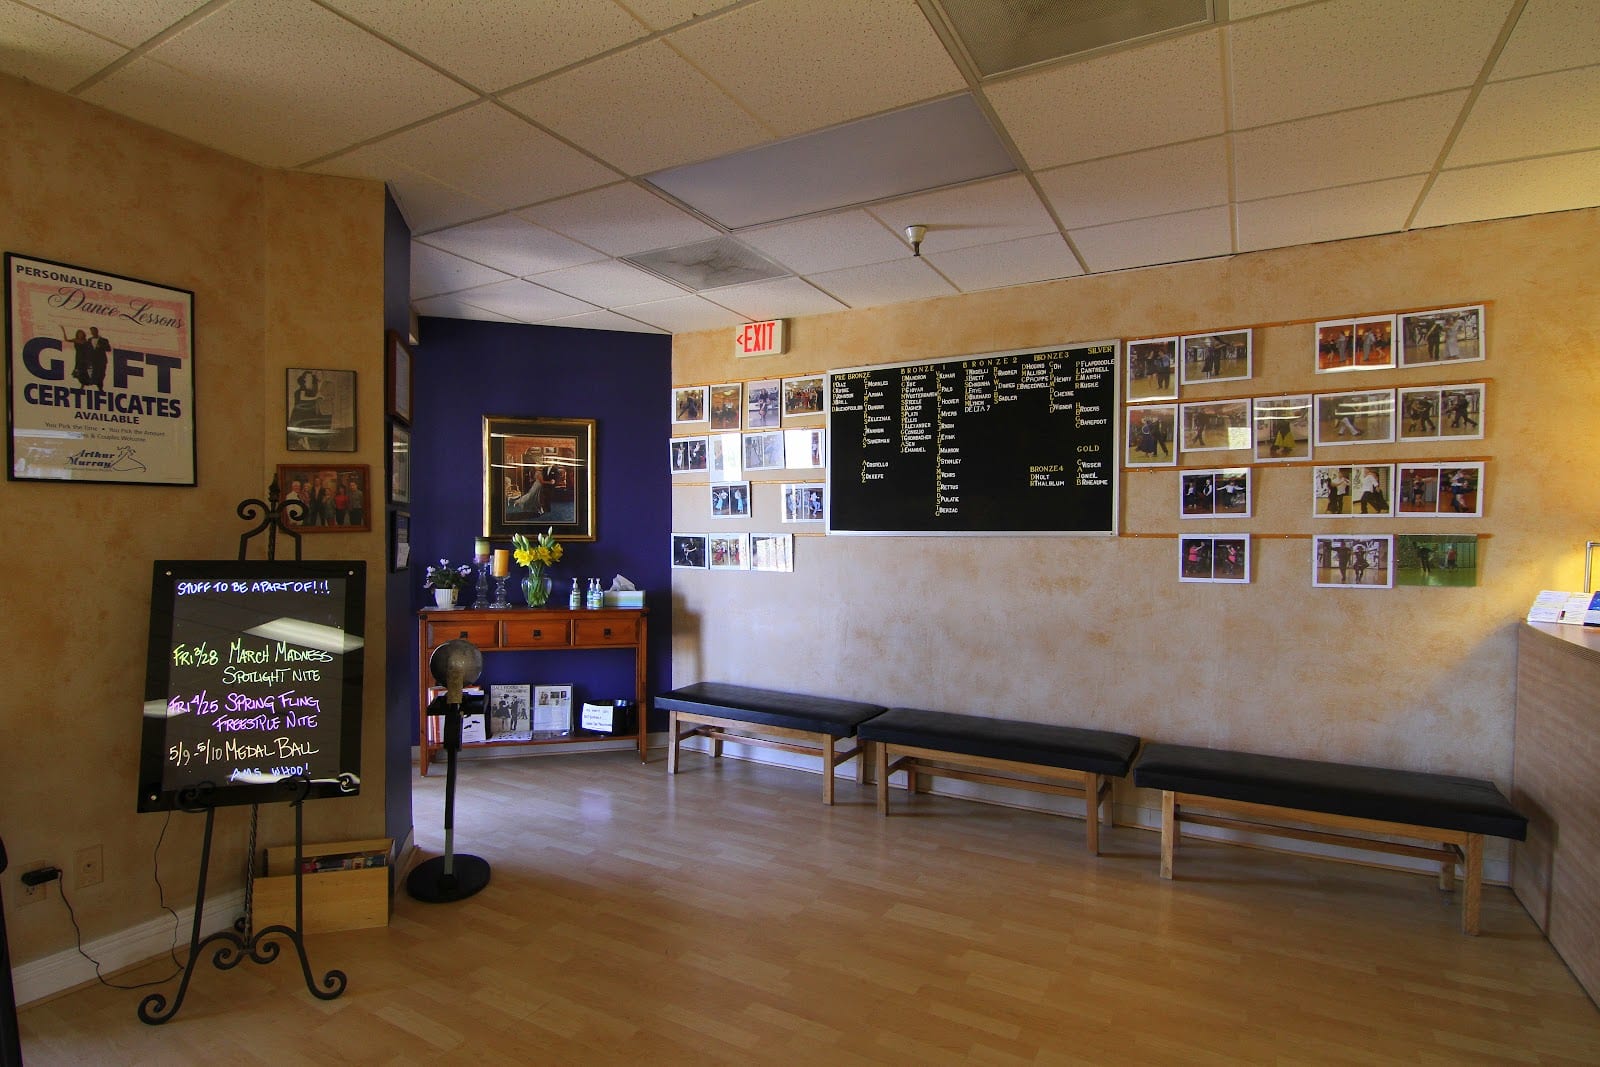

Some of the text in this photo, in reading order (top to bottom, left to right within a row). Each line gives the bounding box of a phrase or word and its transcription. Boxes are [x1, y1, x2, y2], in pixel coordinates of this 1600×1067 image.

[16, 264, 113, 292] PERSONALIZED
[47, 286, 183, 329] Dance Lessons
[744, 322, 775, 353] EXIT
[1033, 351, 1064, 361] BRONZE
[1088, 346, 1112, 355] SILVER
[962, 356, 1018, 369] BRONZE 2
[847, 371, 872, 380] BRONZE
[900, 365, 935, 375] BRONZE
[23, 382, 182, 419] CERTIFICATES
[964, 405, 986, 413] DELTA
[74, 411, 140, 425] AVAILABLE
[78, 449, 115, 459] Arthur
[1076, 445, 1100, 453] GOLD
[67, 456, 113, 469] Murray
[1029, 465, 1059, 473] BRONZE
[177, 581, 211, 596] STUFF
[214, 581, 229, 594] TO
[231, 581, 249, 594] BE
[173, 643, 194, 667] FRI
[229, 637, 270, 665] MARCH
[275, 640, 334, 664] MADNESS
[222, 666, 321, 688] SPOTLIGHT NITE
[167, 690, 321, 716] FRI 4/25 SPRING FLING
[285, 710, 319, 729] NITE
[225, 739, 275, 762] MEDAL
[274, 736, 320, 760] BALL
